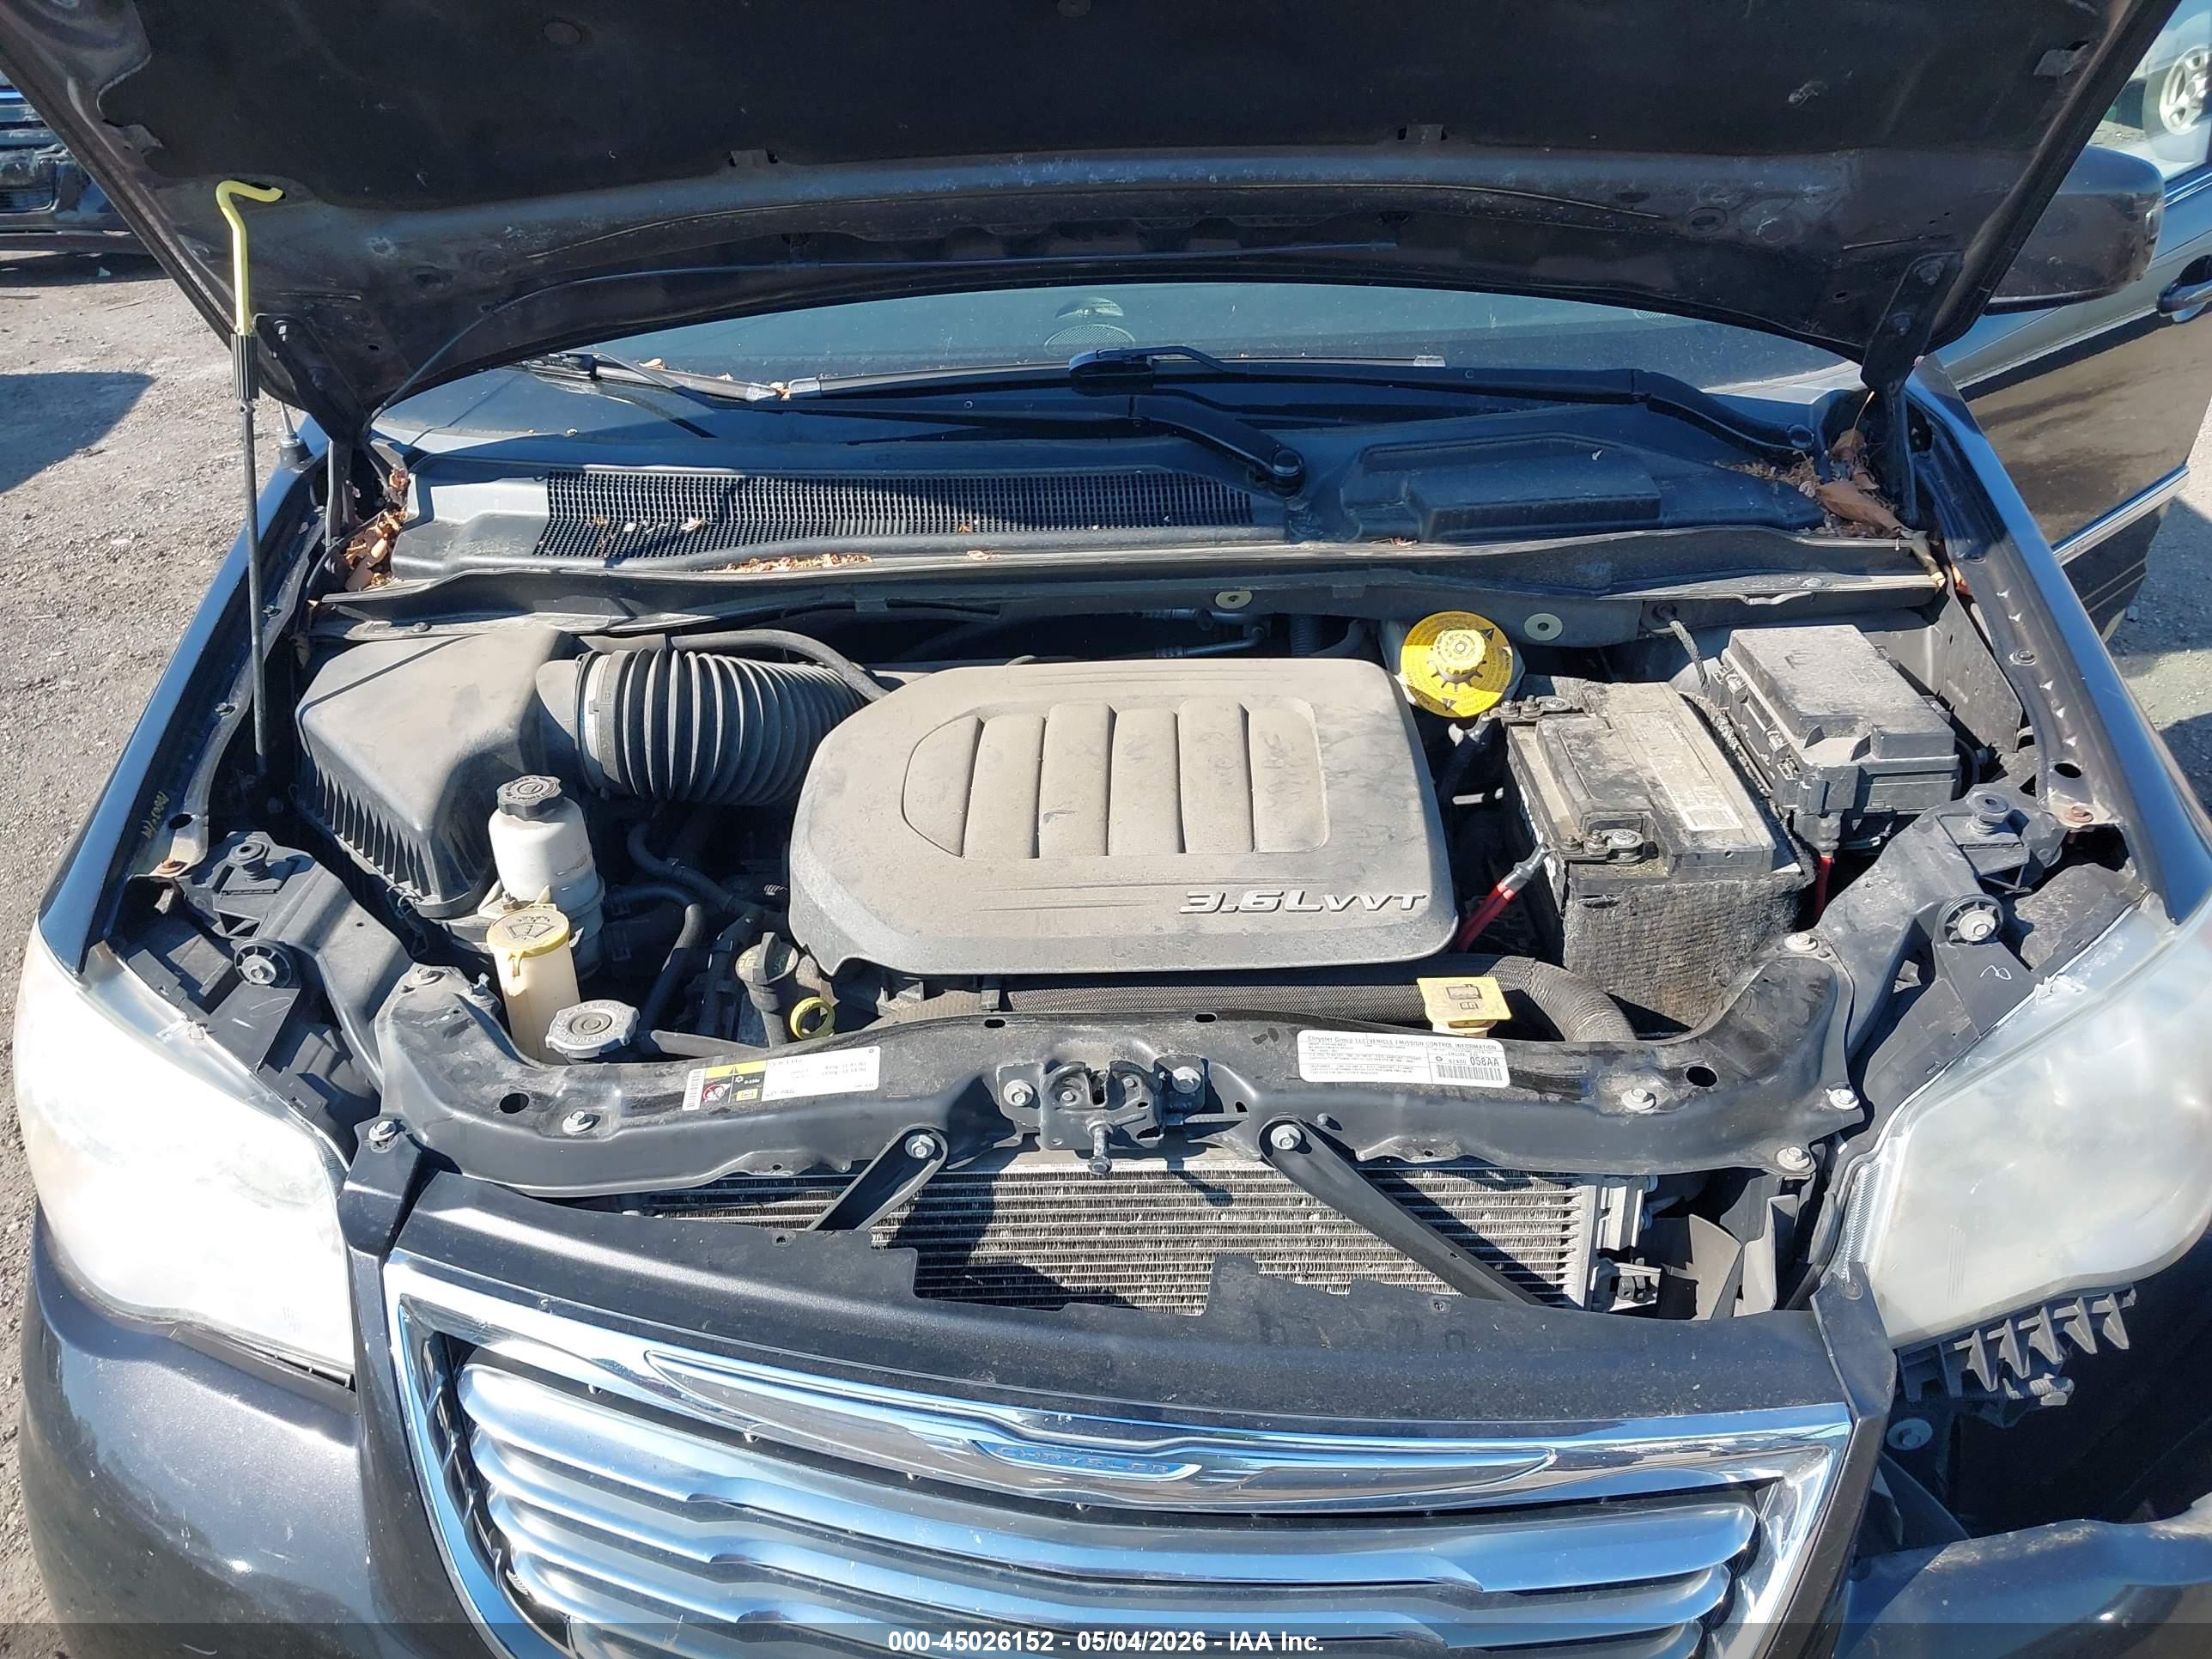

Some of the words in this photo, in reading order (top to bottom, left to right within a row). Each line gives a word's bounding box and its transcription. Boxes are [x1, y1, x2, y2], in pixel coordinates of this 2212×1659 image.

[1179, 890, 1324, 915] 3.6L
[1322, 893, 1428, 913] VVT
[1469, 1056, 1500, 1066] 058AA
[995, 1443, 1169, 1474] CHRYSLER
